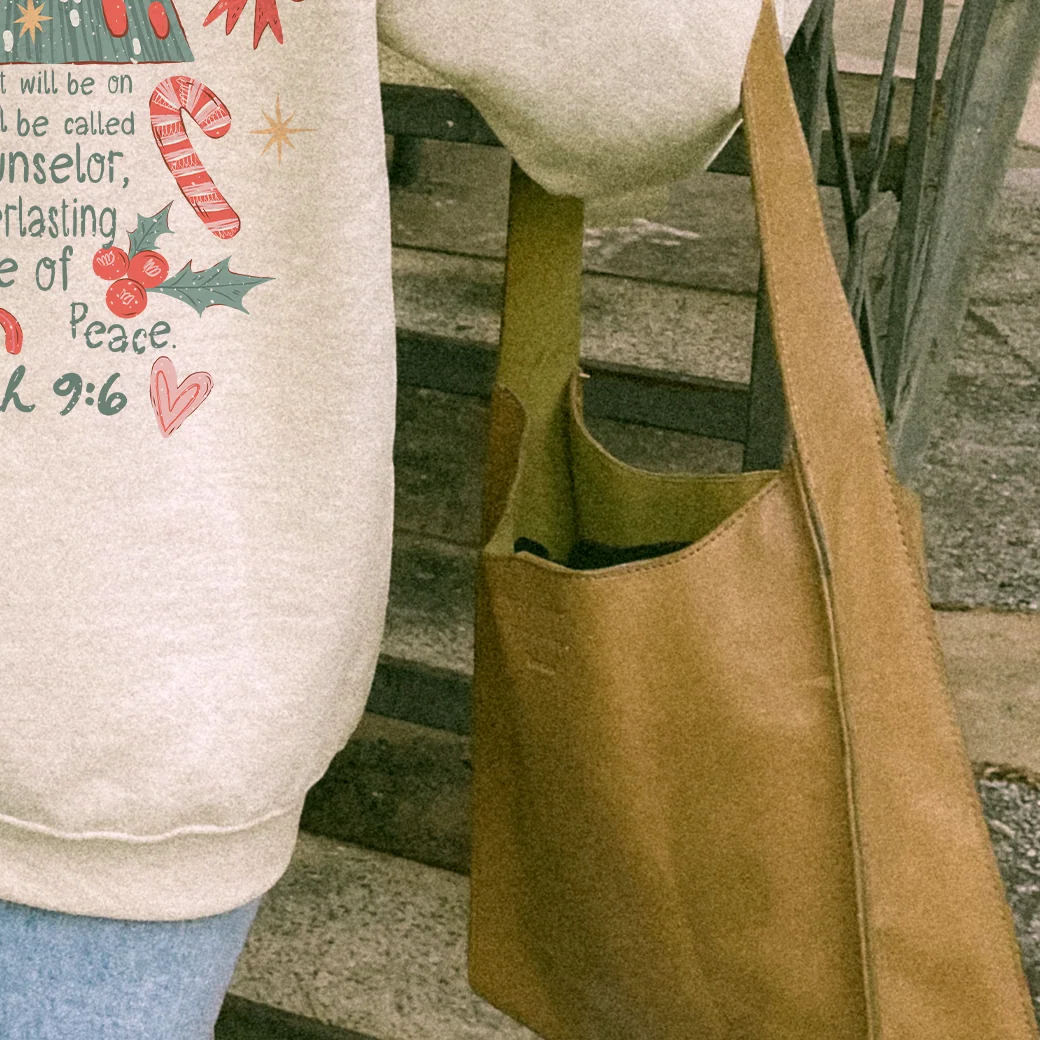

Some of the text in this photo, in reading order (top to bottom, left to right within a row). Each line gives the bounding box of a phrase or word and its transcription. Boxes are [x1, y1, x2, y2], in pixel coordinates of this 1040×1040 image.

[21, 73, 57, 94] will
[68, 73, 94, 95] be
[110, 76, 132, 92] on
[18, 109, 48, 136] be
[65, 113, 134, 135] called
[36, 246, 73, 290] of
[70, 301, 177, 355] Peace.
[54, 373, 127, 415] 9:6
